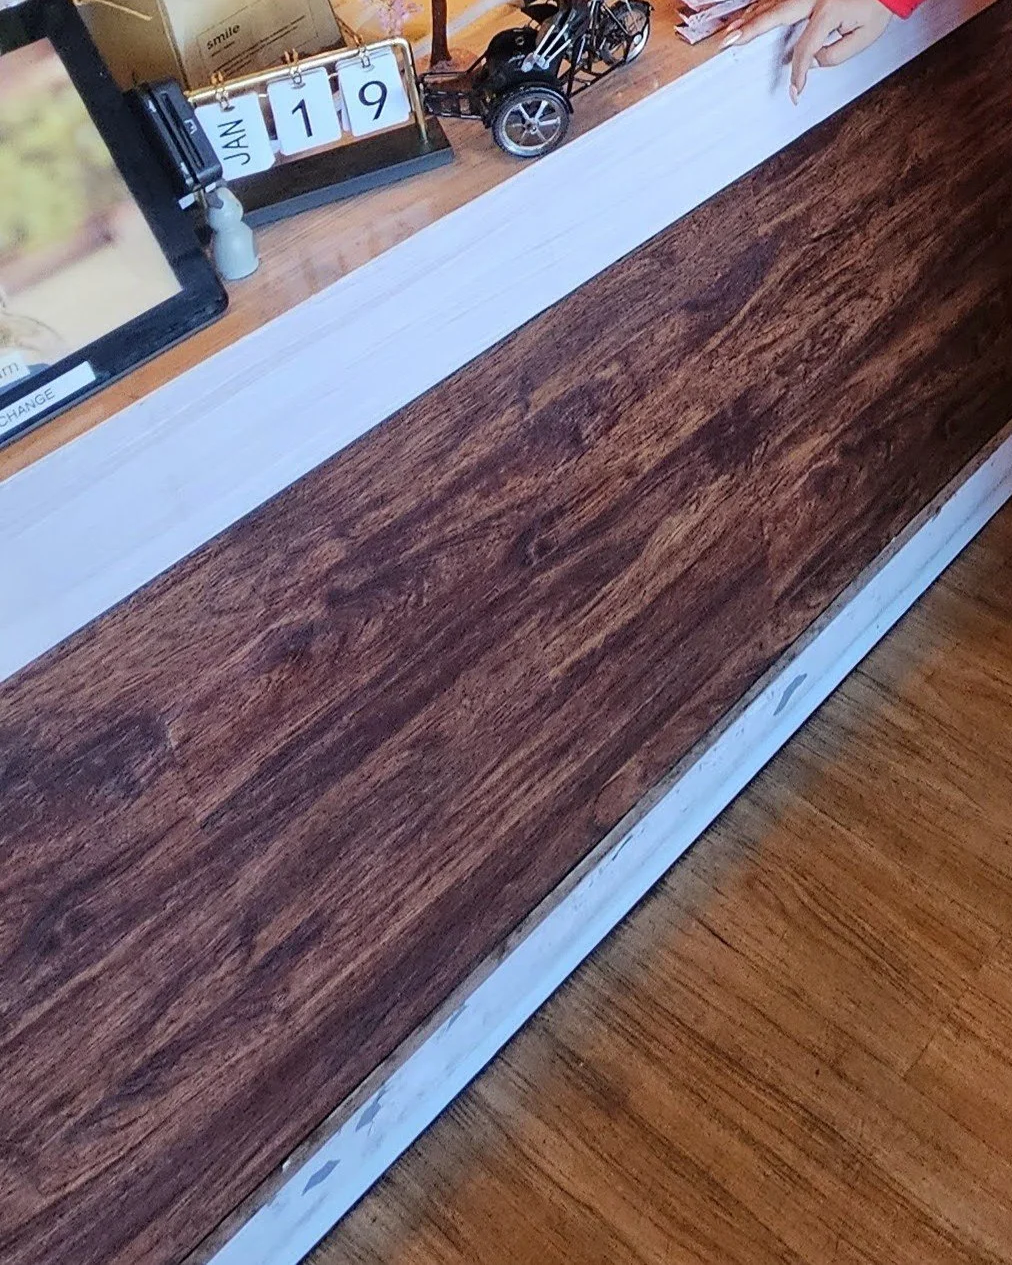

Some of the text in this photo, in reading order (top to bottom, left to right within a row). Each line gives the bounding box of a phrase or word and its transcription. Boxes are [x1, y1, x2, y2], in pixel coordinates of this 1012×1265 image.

[206, 24, 240, 50] smile
[217, 80, 388, 165] JAN 1 9
